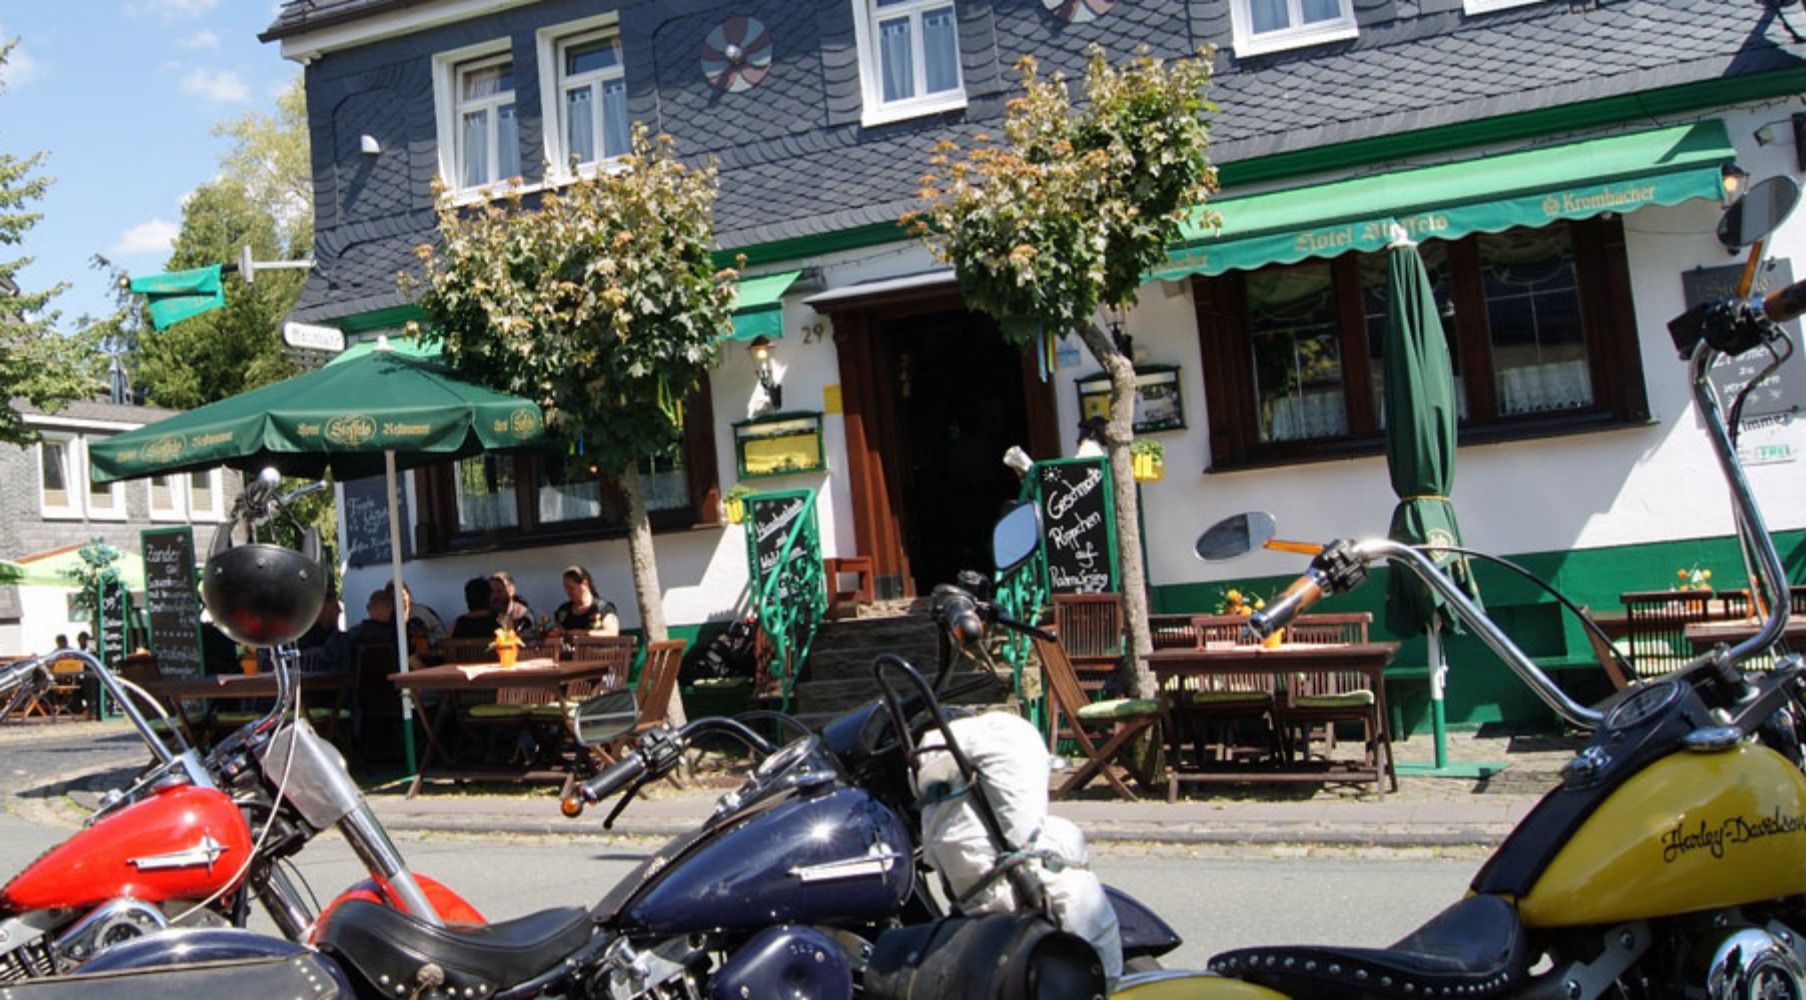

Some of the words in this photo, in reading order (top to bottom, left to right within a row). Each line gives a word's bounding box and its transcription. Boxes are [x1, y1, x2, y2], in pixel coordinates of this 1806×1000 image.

[1562, 187, 1656, 212] Krombacher
[1296, 227, 1352, 250] Hotel
[801, 323, 824, 345] 29
[146, 543, 181, 563] Zander
